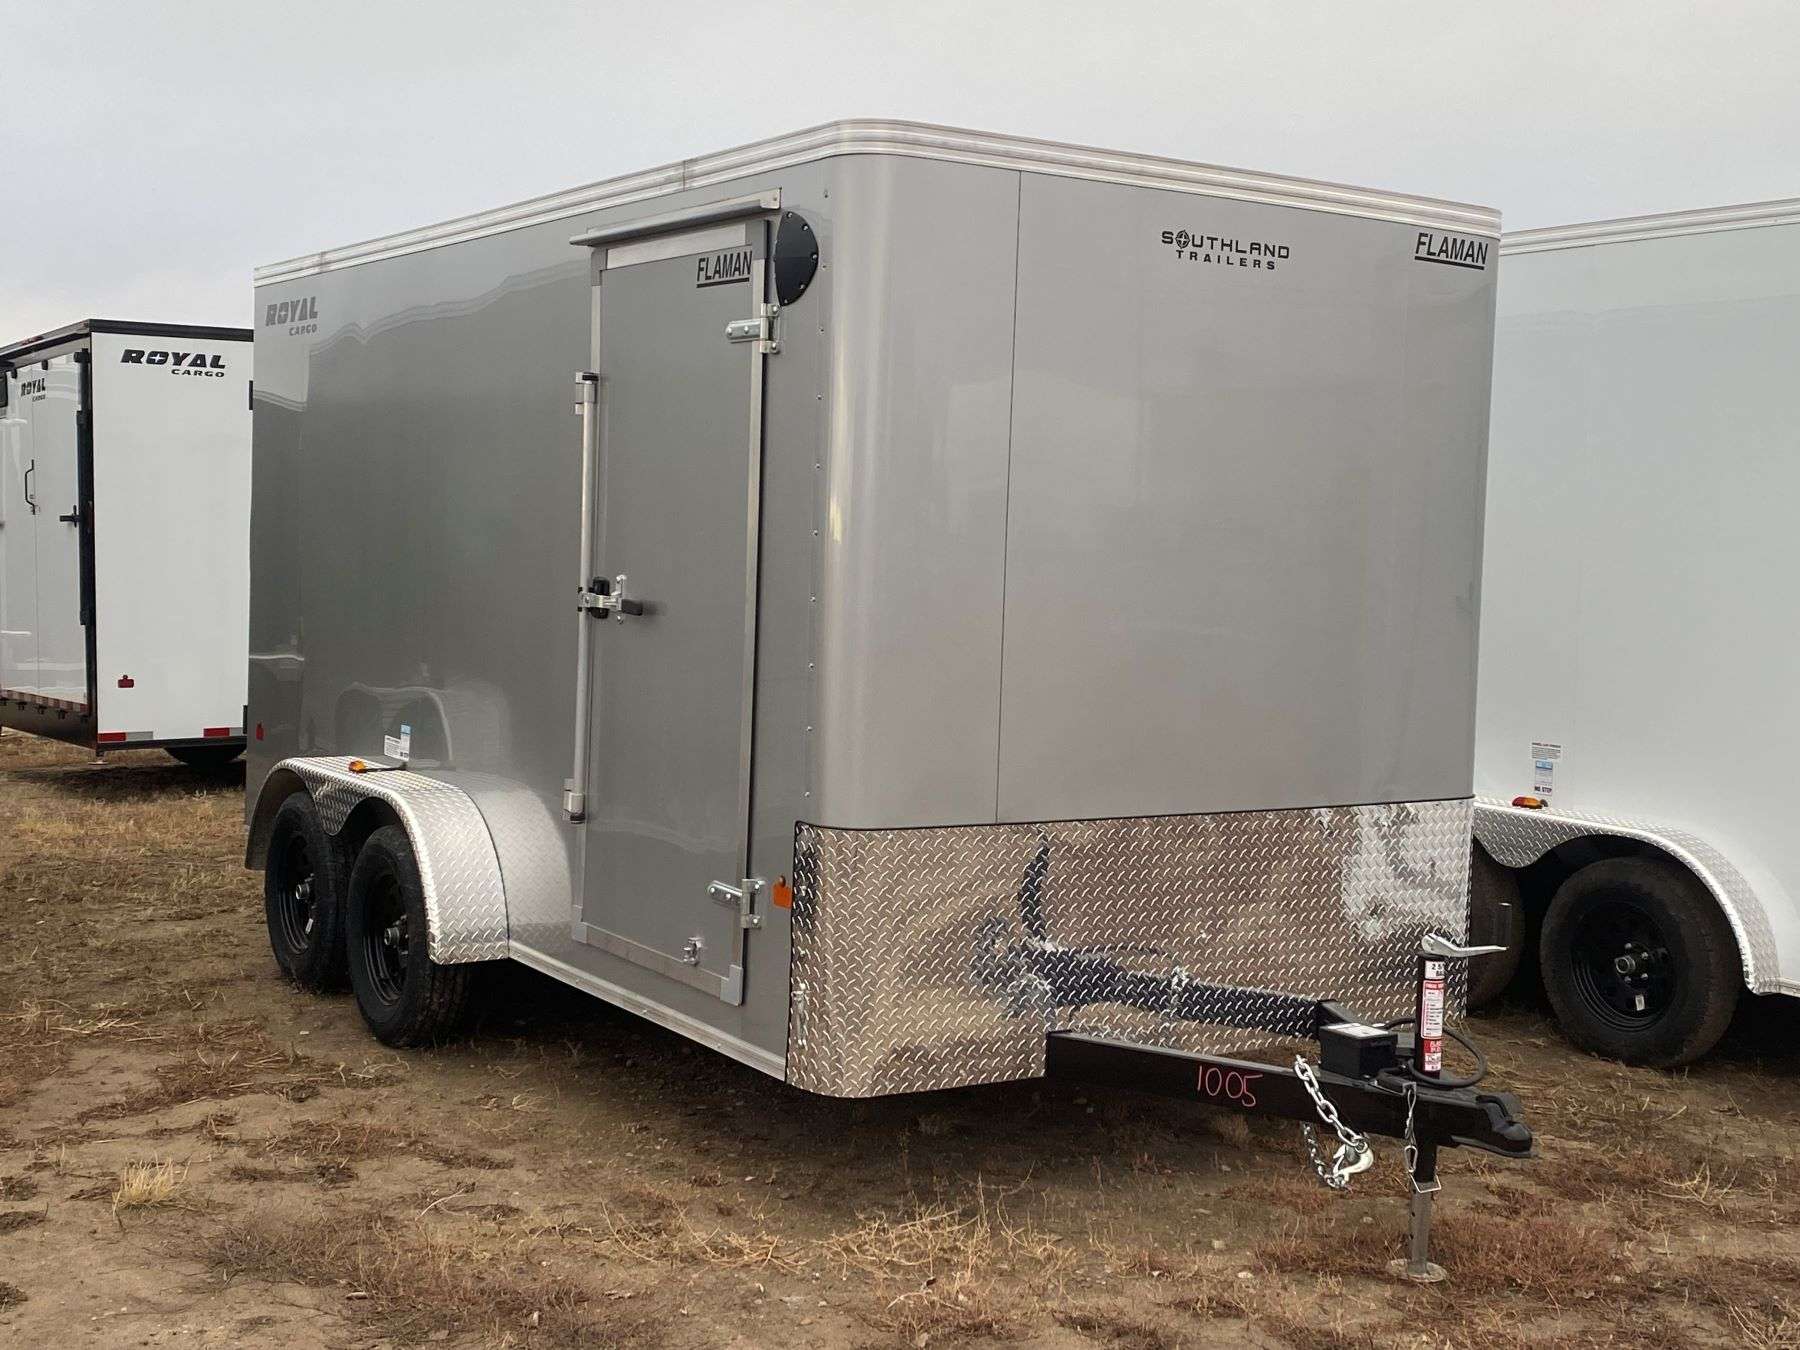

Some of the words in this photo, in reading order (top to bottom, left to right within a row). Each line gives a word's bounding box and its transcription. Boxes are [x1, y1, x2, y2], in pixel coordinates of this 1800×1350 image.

[1161, 230, 1290, 259] SOUTHLAND
[1415, 232, 1488, 265] FLAMAN
[697, 250, 752, 281] FLAMAN
[1176, 250, 1276, 270] TRAILERS
[265, 296, 318, 327] ROYAL
[289, 323, 317, 336] CARGO
[120, 349, 226, 369] ROYAL
[171, 368, 225, 378] CARGO
[21, 377, 46, 397] ROYAL
[1197, 1065, 1263, 1107] 1005
